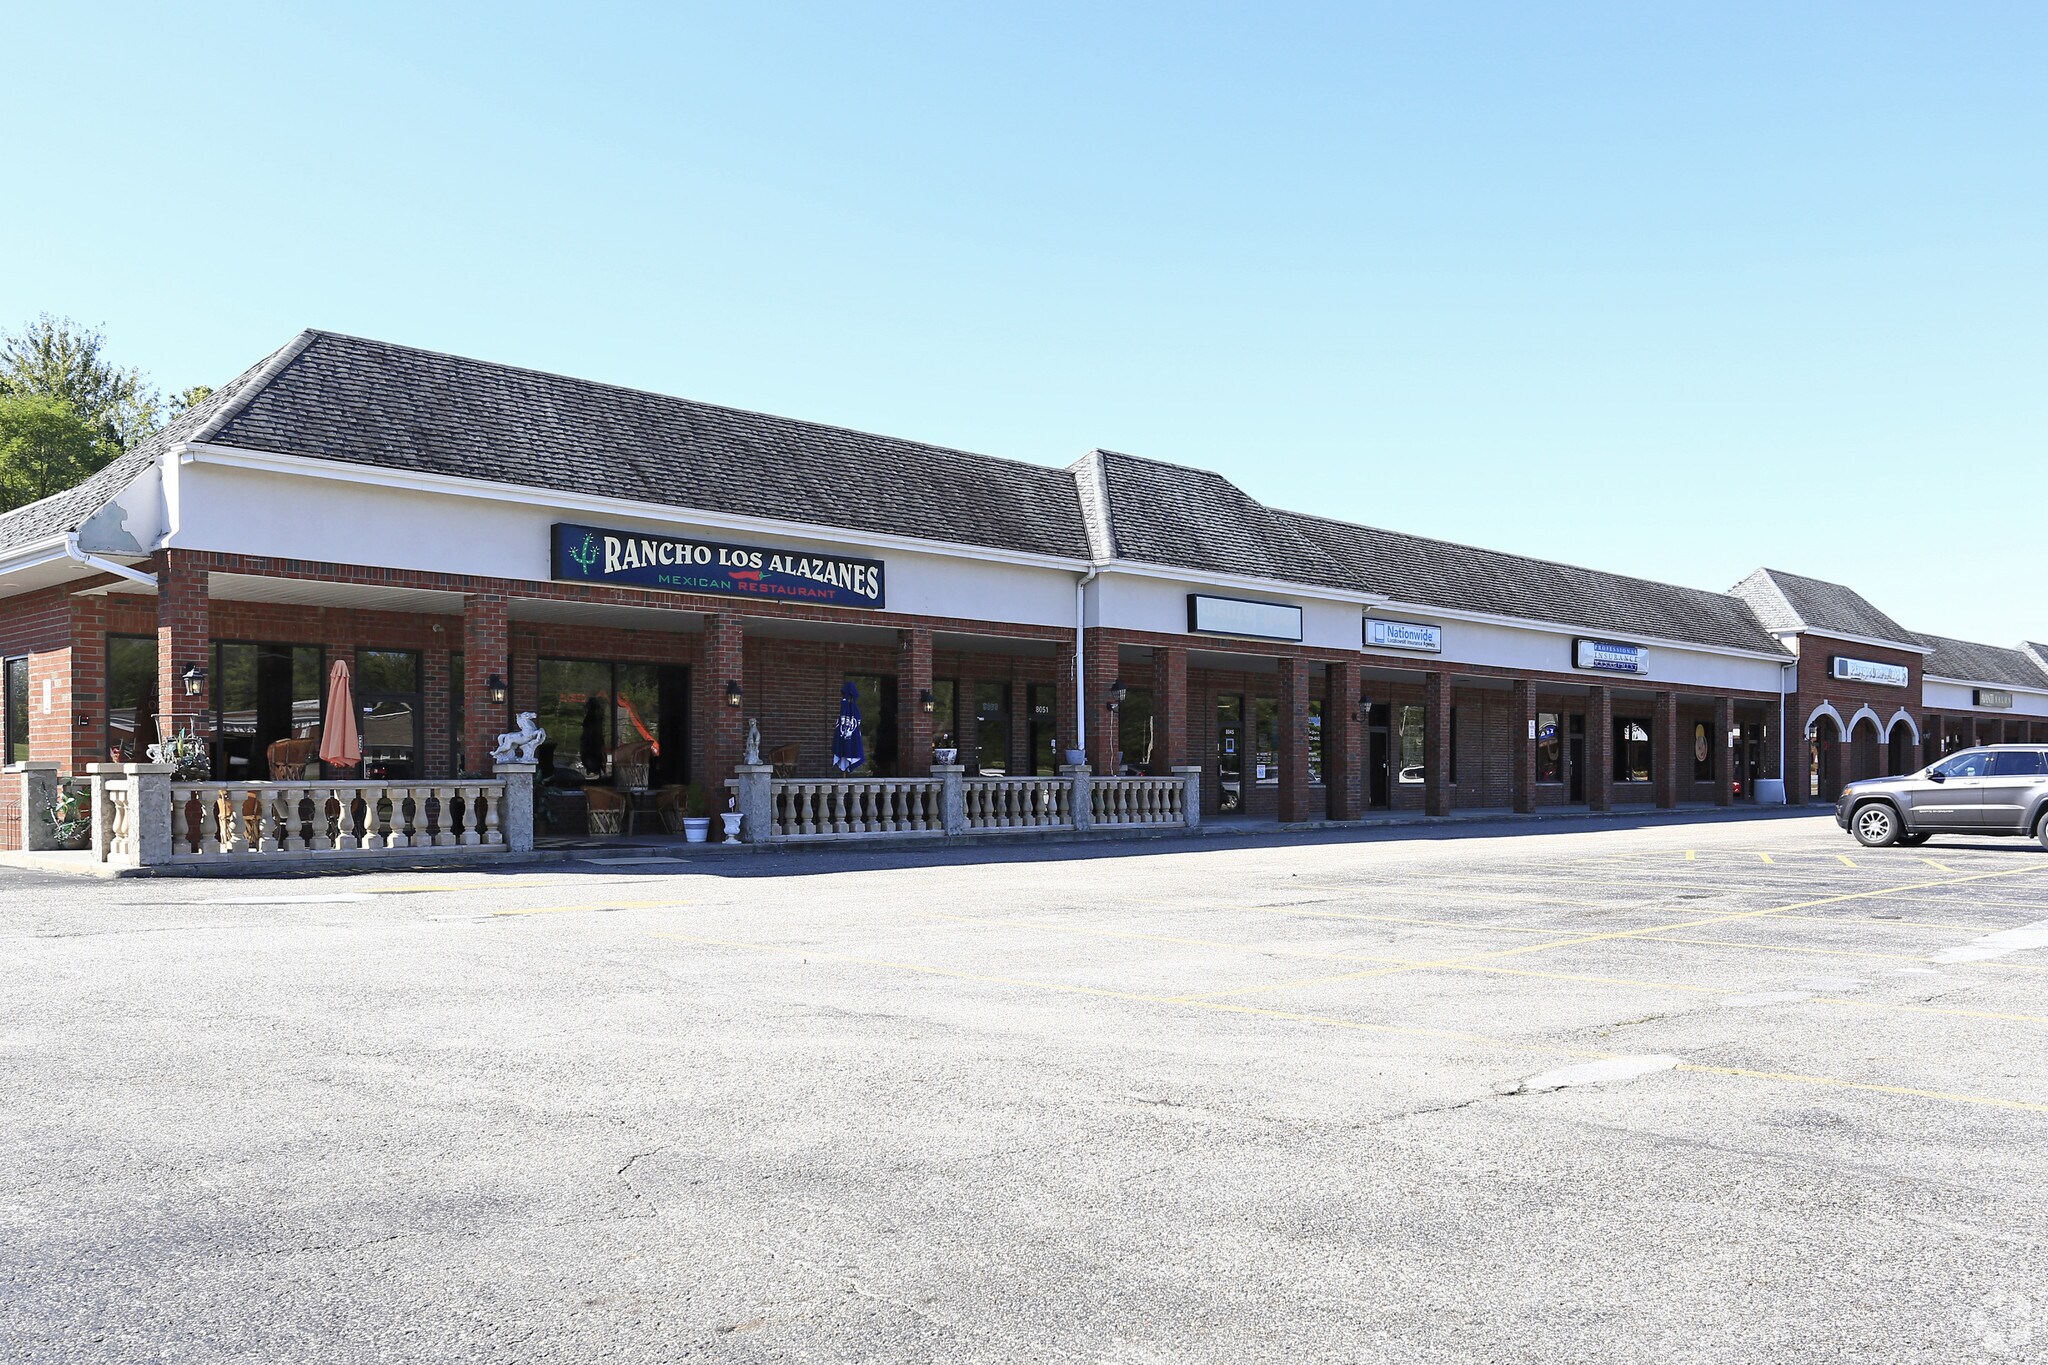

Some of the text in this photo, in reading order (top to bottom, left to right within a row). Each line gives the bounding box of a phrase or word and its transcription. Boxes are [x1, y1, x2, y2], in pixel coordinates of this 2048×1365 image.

[604, 535, 879, 600] RANCHO LOS ALAZANES
[658, 574, 836, 599] MEXICAN RESTAURANT
[1387, 625, 1433, 642] Nationwide
[1594, 645, 1638, 655] PROFESSIONAL
[1594, 652, 1638, 662] INSURANCE
[1035, 705, 1049, 714] 8051
